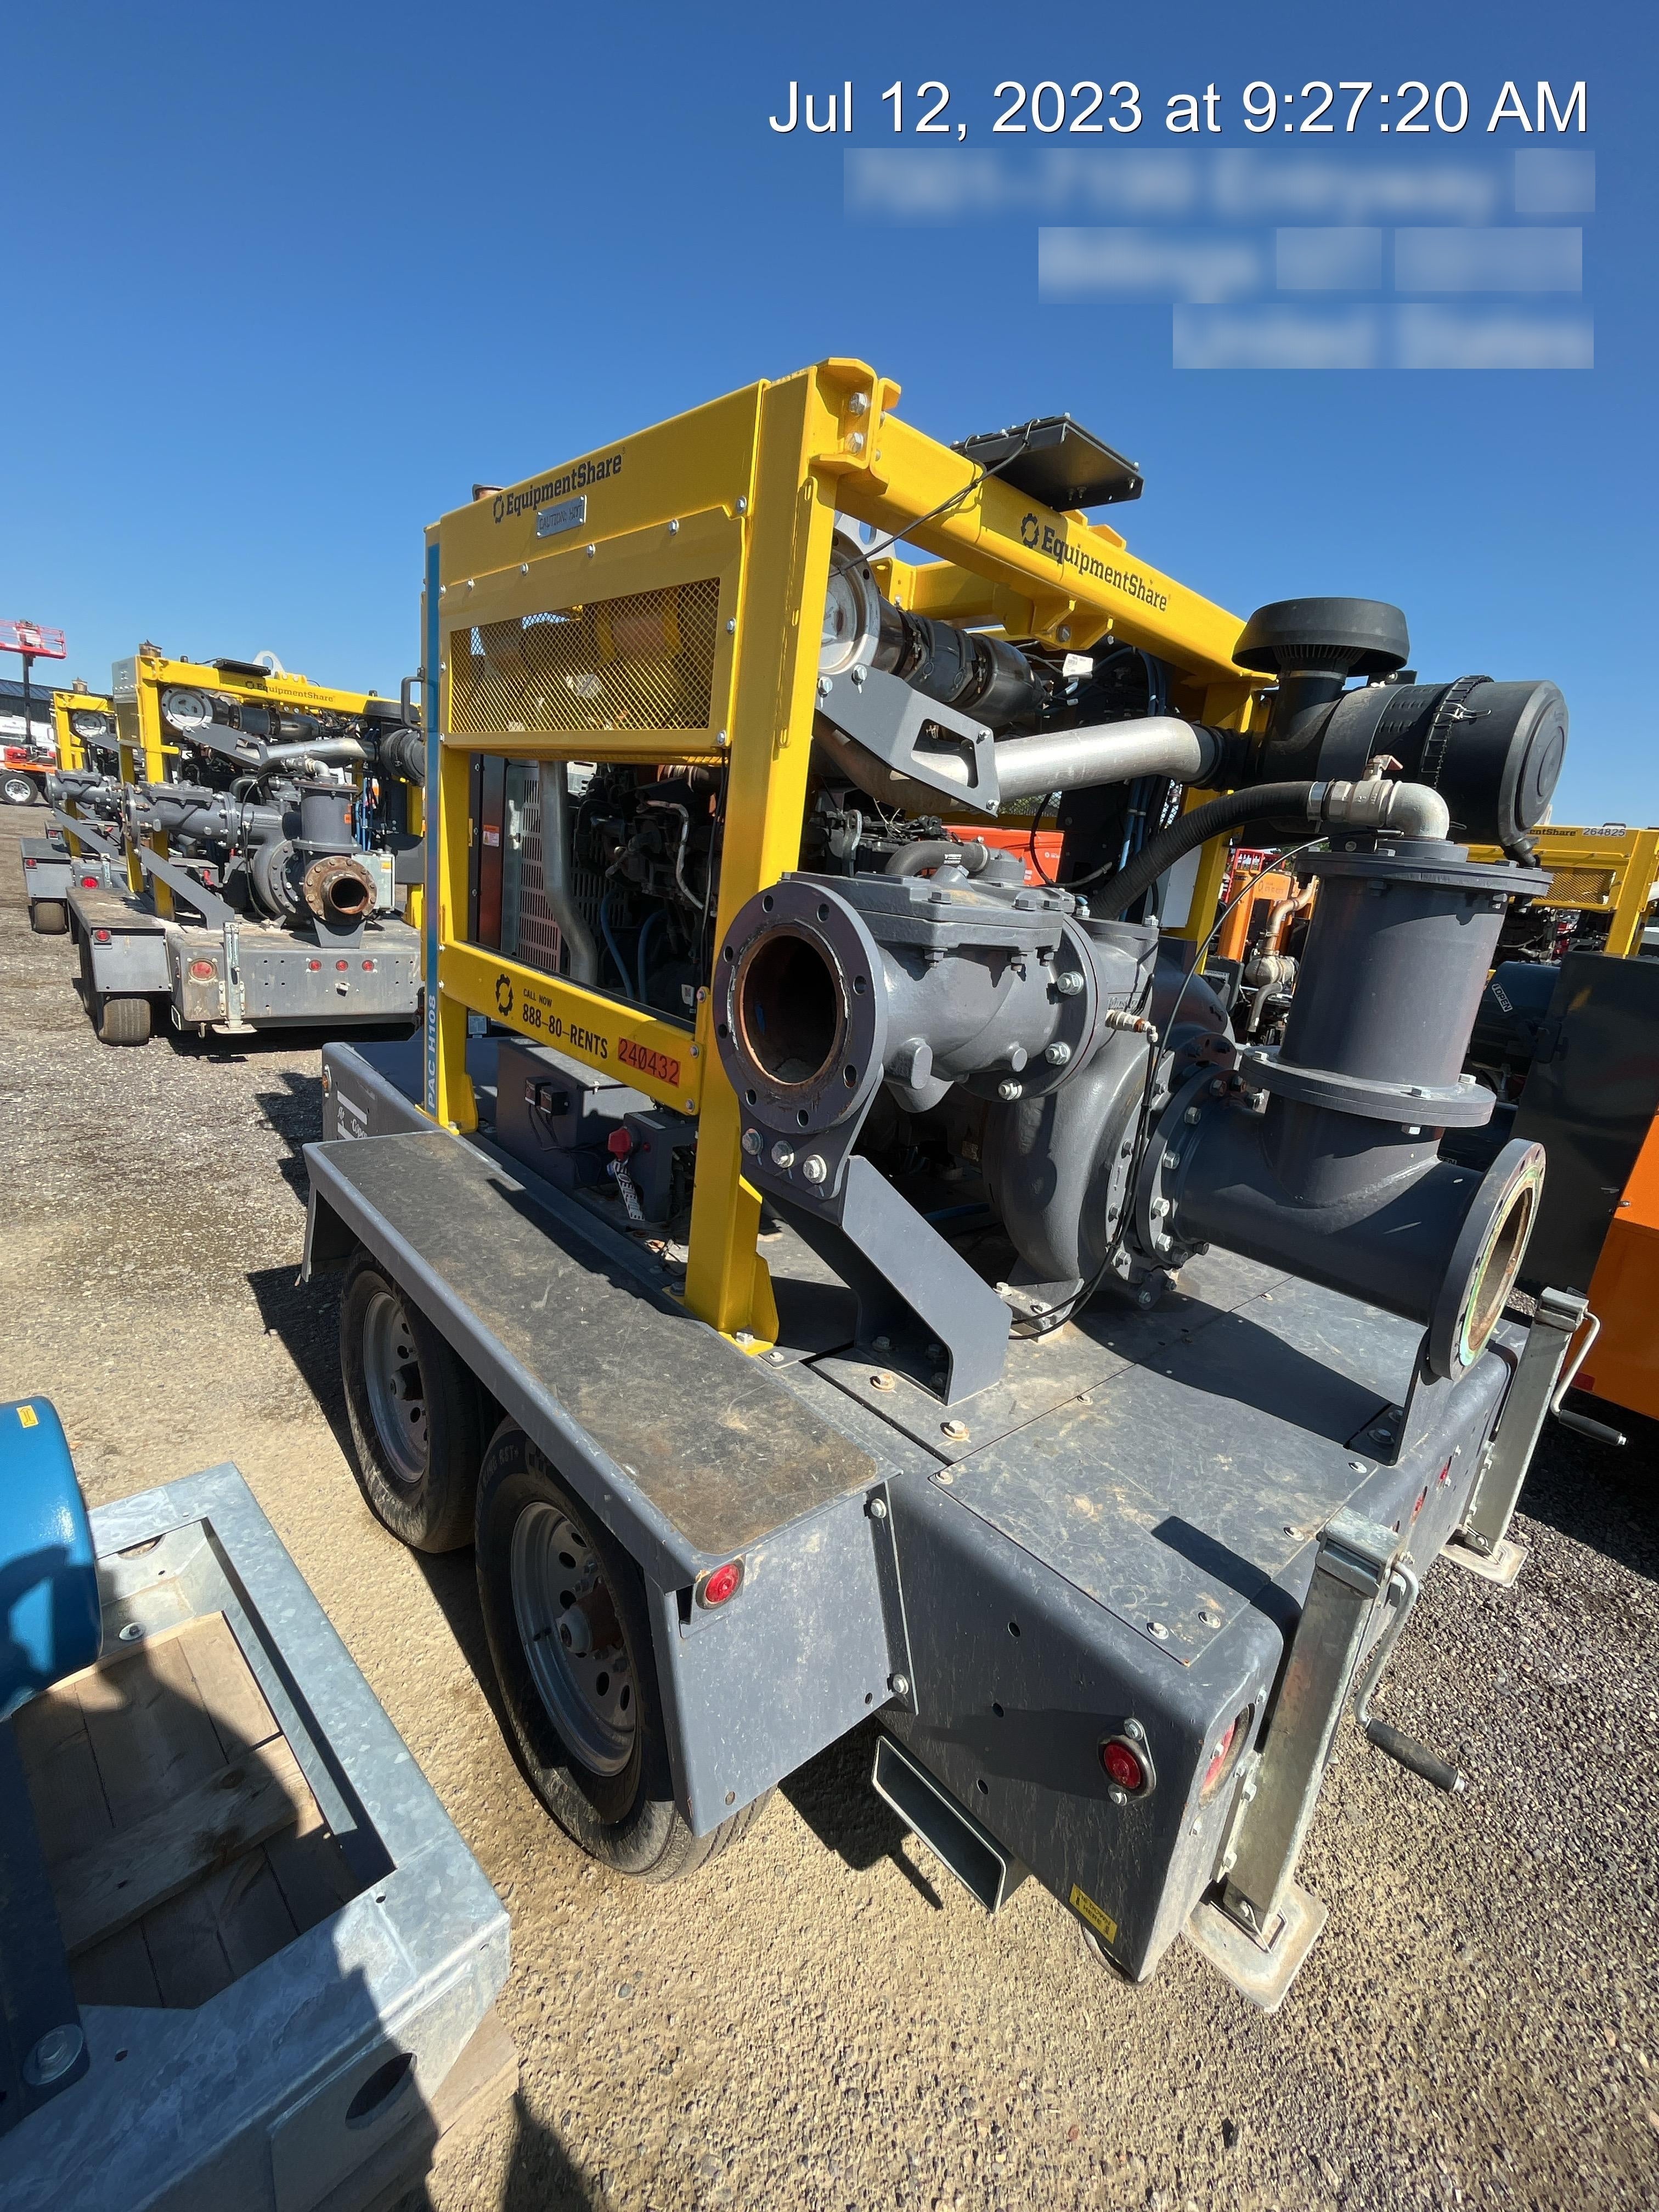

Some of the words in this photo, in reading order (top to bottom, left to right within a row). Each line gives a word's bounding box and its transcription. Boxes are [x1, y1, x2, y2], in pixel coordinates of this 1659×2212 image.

[506, 454, 622, 516] EquipmentShare
[1041, 524, 1167, 612] EquipmentShare
[257, 683, 334, 702] EquipmentShare
[1527, 828, 1576, 837] entShare
[1583, 827, 1626, 837] 264825
[523, 989, 537, 1002] CALL
[539, 994, 552, 1008] NOW
[1495, 988, 1511, 1011] OPEN
[428, 995, 436, 1054] H108
[618, 1038, 680, 1086] 240432
